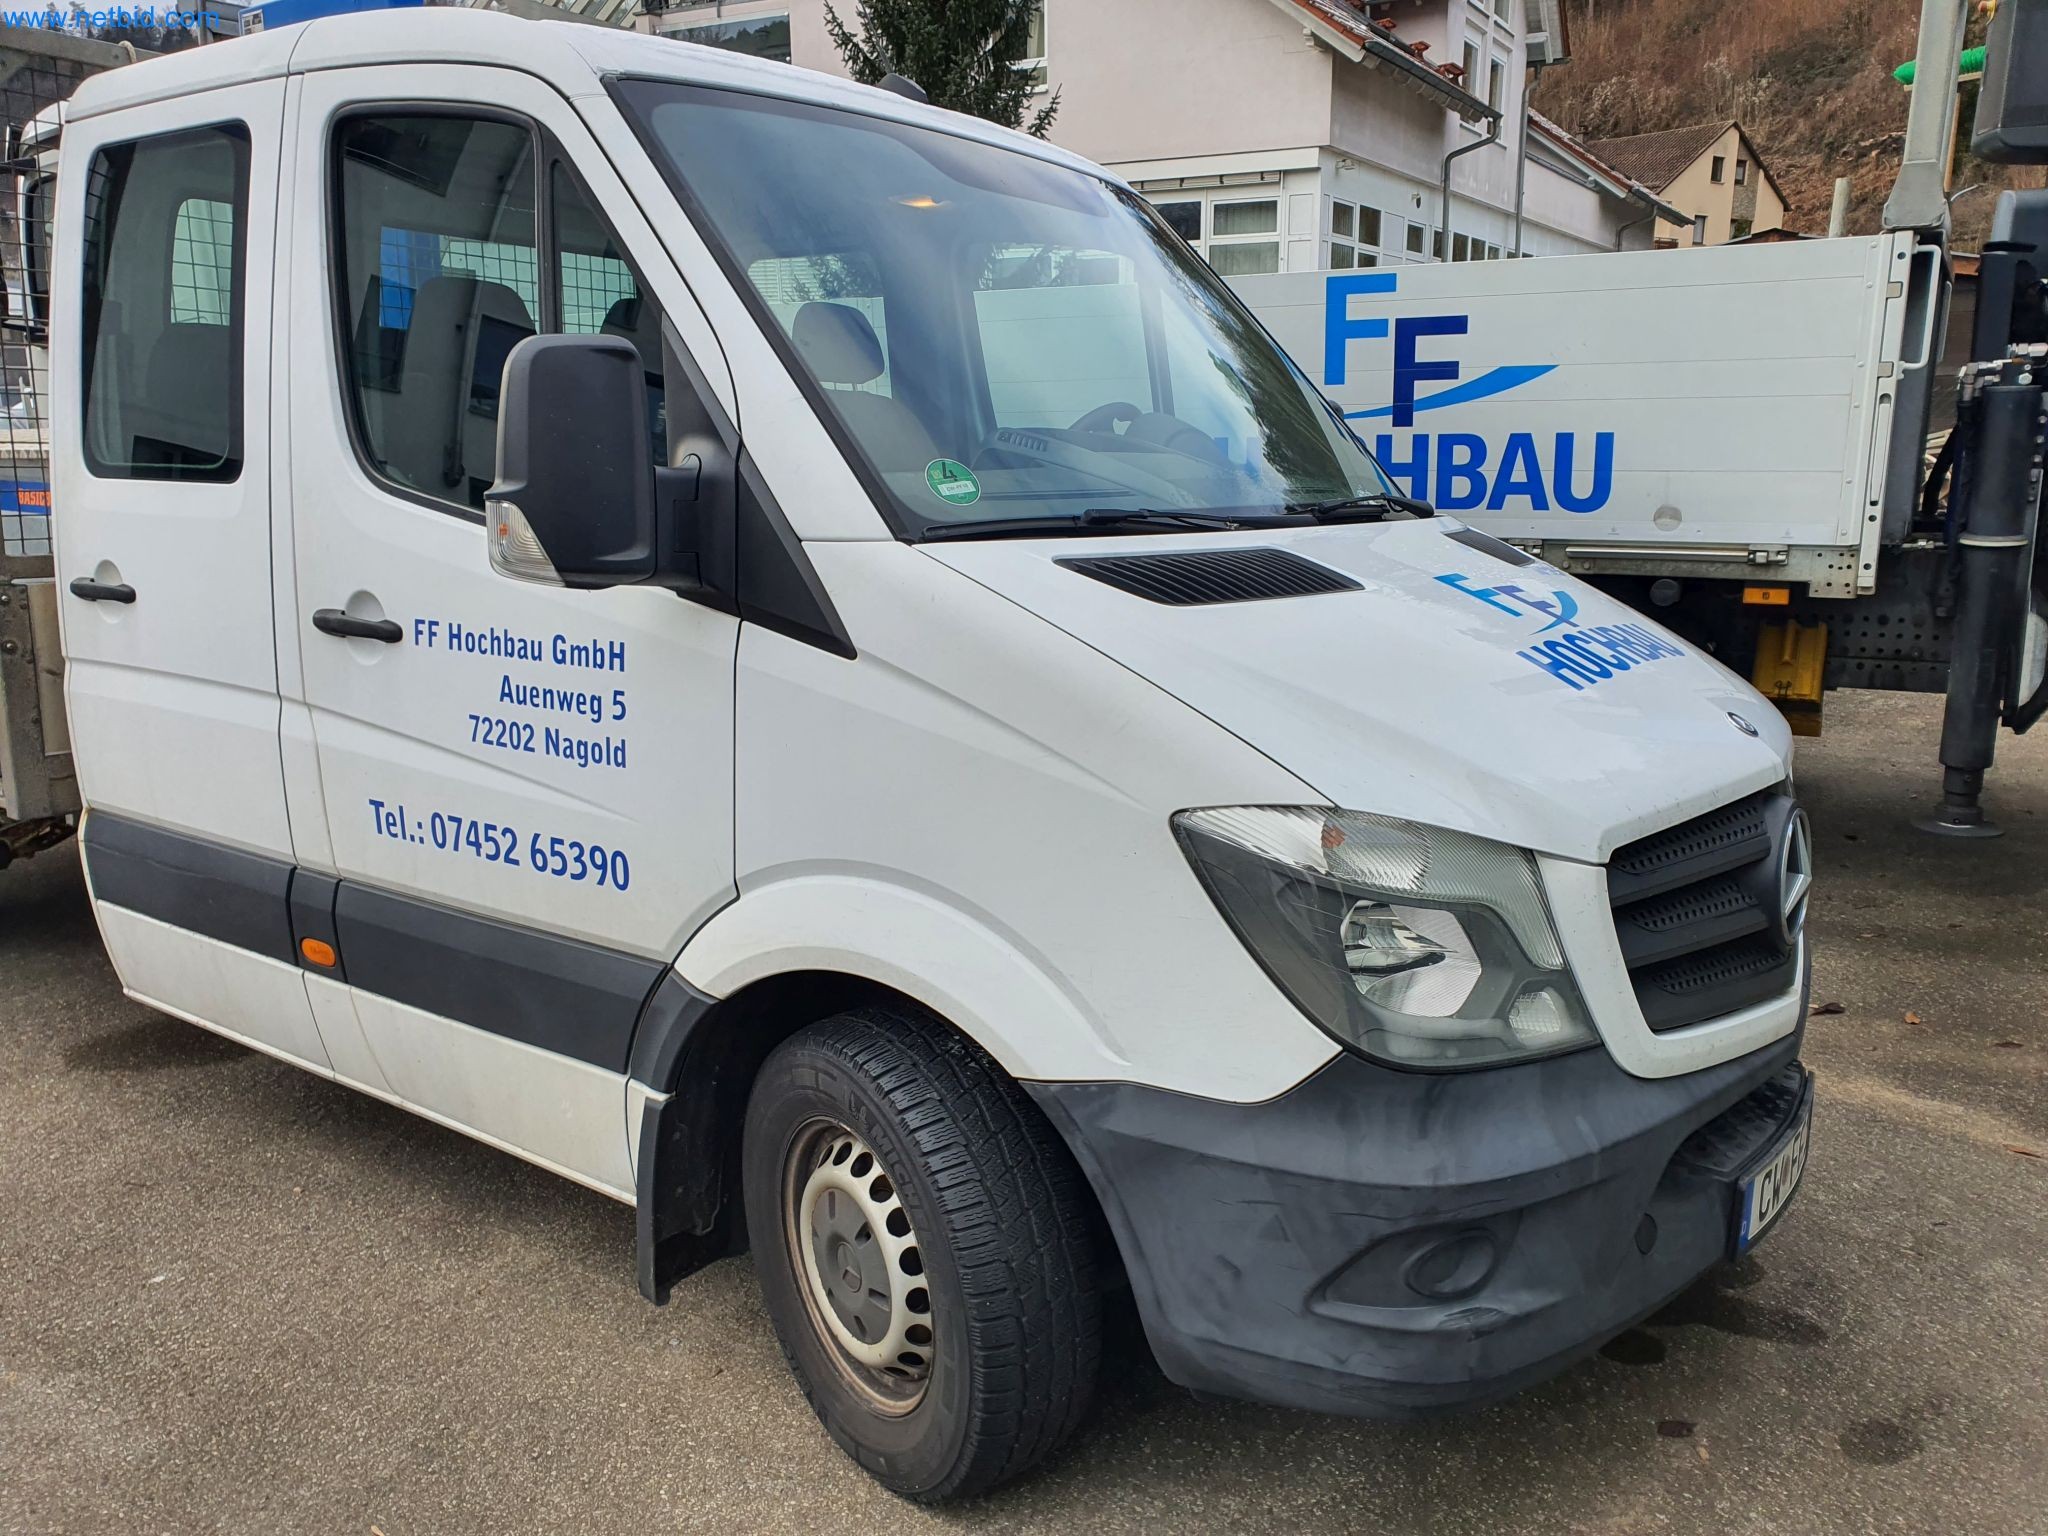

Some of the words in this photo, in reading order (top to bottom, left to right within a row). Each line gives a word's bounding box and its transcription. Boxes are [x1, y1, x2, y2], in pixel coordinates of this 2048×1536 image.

[414, 618, 440, 648] FF
[448, 622, 542, 662] Hochbau
[552, 633, 626, 673] GmbH
[1516, 623, 1686, 691] HOCHBAU
[499, 675, 602, 724] Auenweg
[612, 690, 627, 721] 5
[468, 714, 536, 753] 72202
[545, 726, 627, 769] Nagold
[368, 798, 425, 845] Tel.:
[430, 811, 521, 867] 07452
[530, 832, 631, 892] 65390
